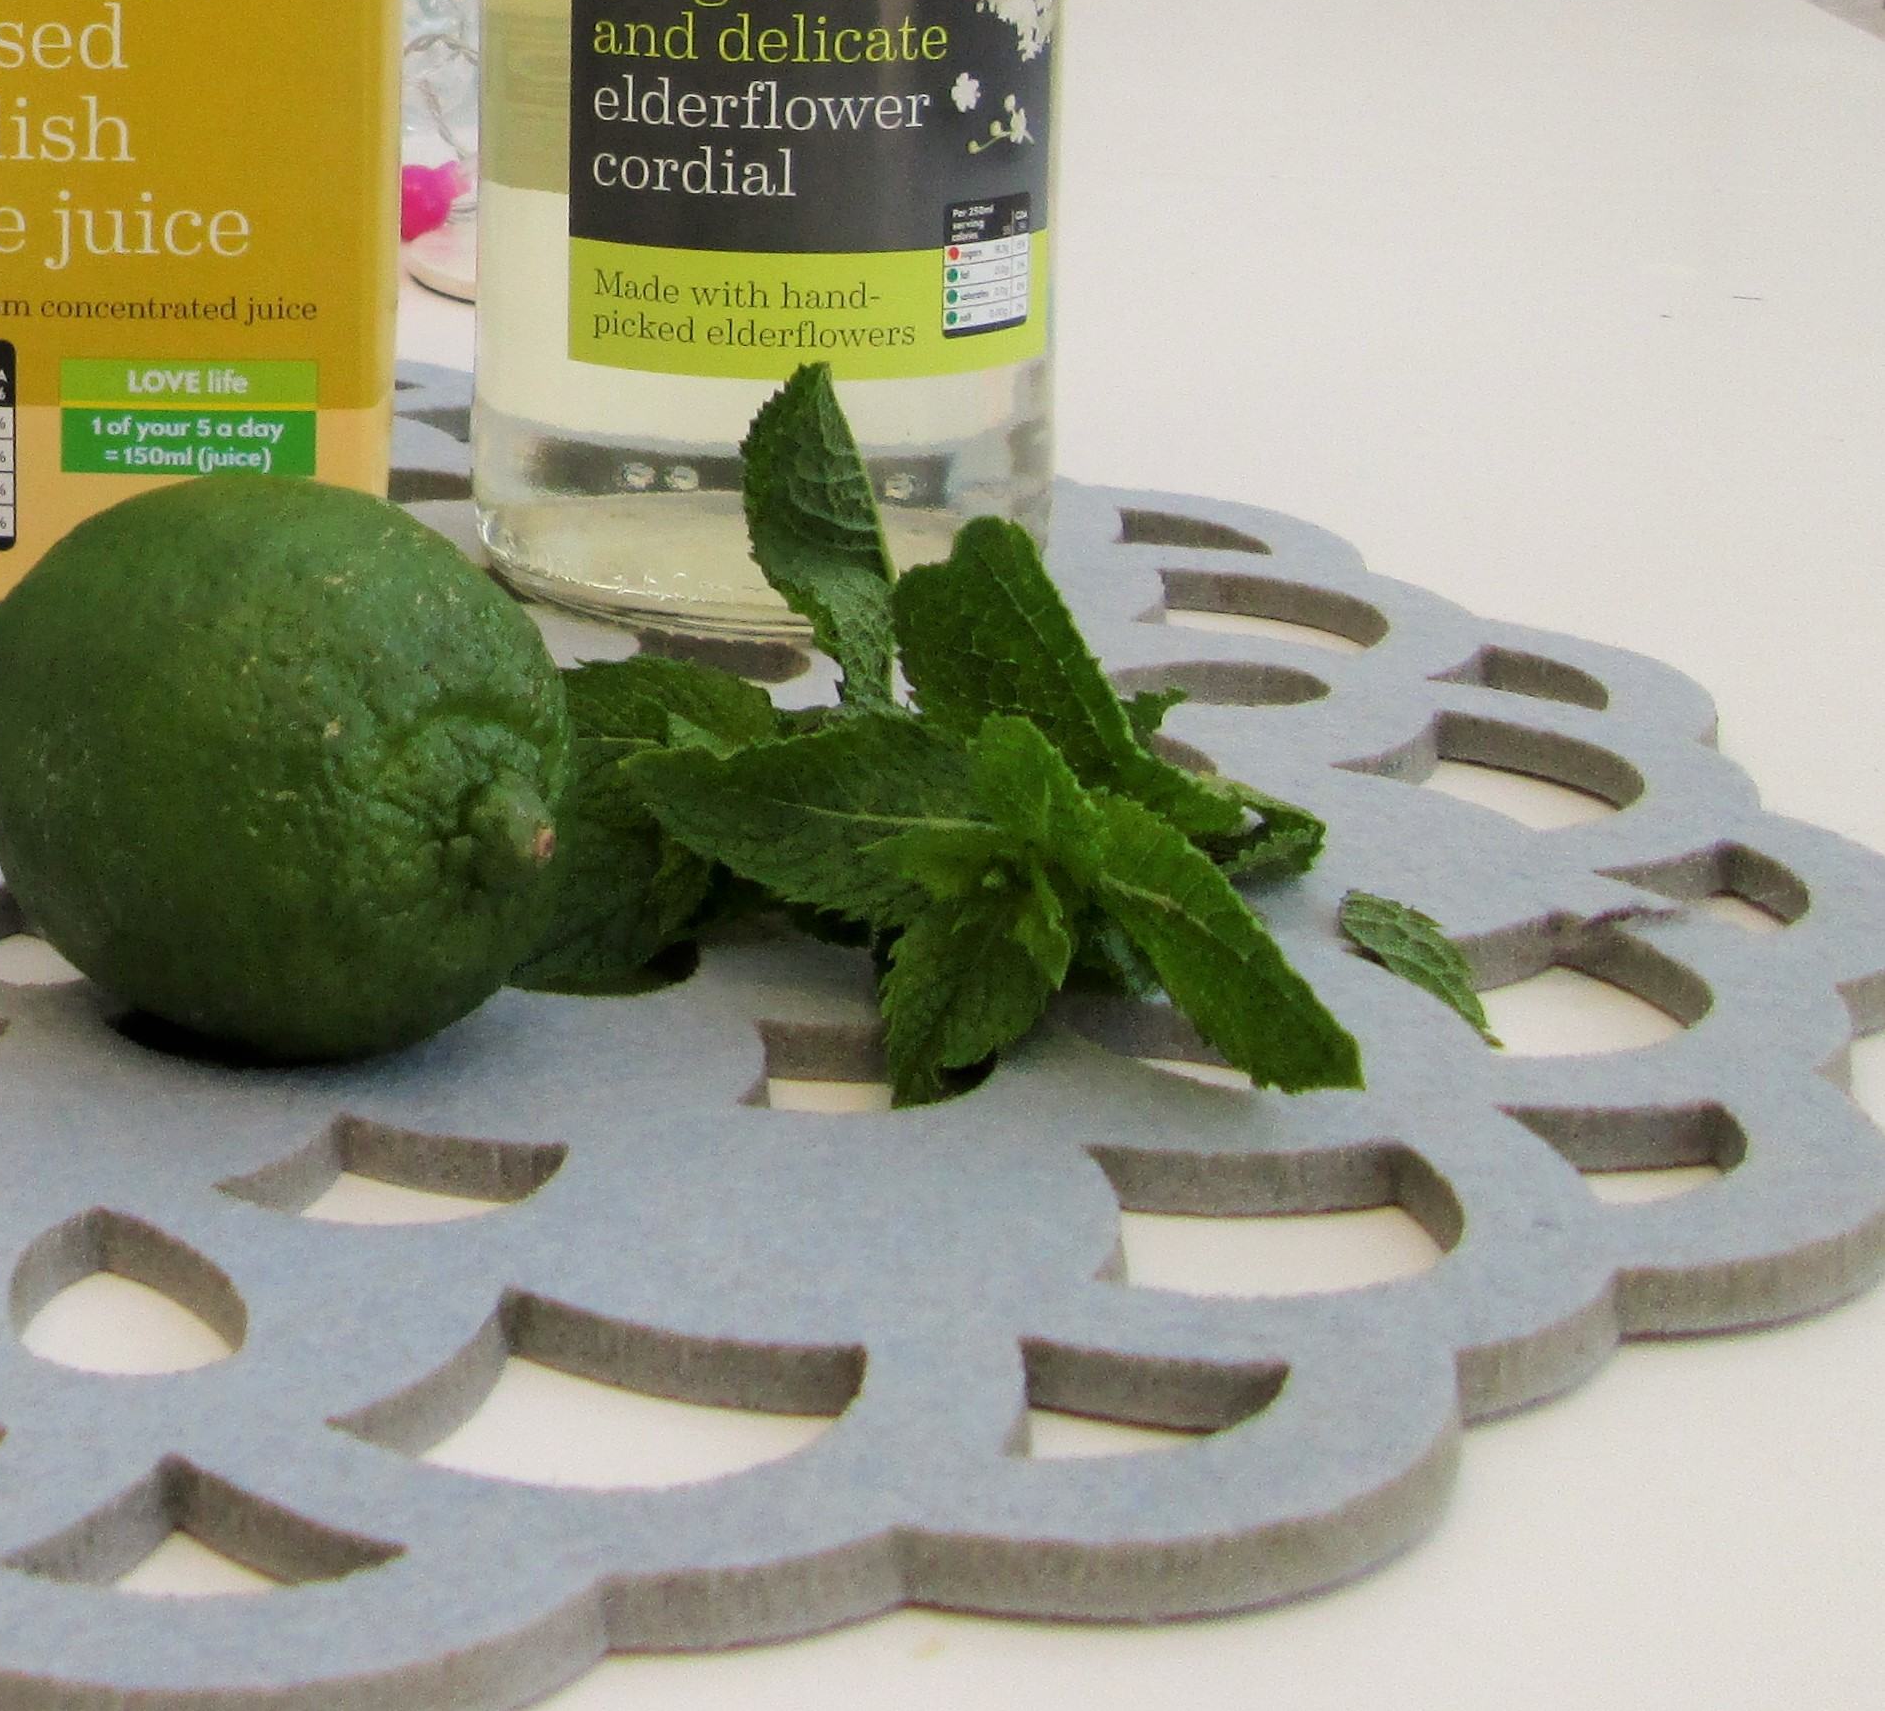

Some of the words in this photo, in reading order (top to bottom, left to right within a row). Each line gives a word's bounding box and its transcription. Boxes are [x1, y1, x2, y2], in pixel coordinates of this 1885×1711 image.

[592, 11, 700, 61] and
[717, 13, 949, 64] delicate
[592, 74, 932, 132] elderflower
[592, 145, 798, 198] cordial
[43, 189, 251, 271] juice
[40, 296, 238, 321] concentrated
[243, 296, 318, 326] juice
[593, 268, 681, 305] Made
[691, 279, 770, 310] with
[780, 280, 882, 312] hand-
[592, 308, 696, 345] picked
[706, 317, 917, 351] elderflowers
[127, 368, 201, 395] LOVE
[207, 368, 250, 394] life
[91, 416, 102, 436] 1
[106, 414, 132, 437] of
[136, 421, 191, 442] your
[196, 418, 212, 437] 5
[217, 422, 233, 438] a
[237, 417, 284, 444] day
[123, 445, 193, 467] 150ml
[197, 446, 272, 474] (juice)
